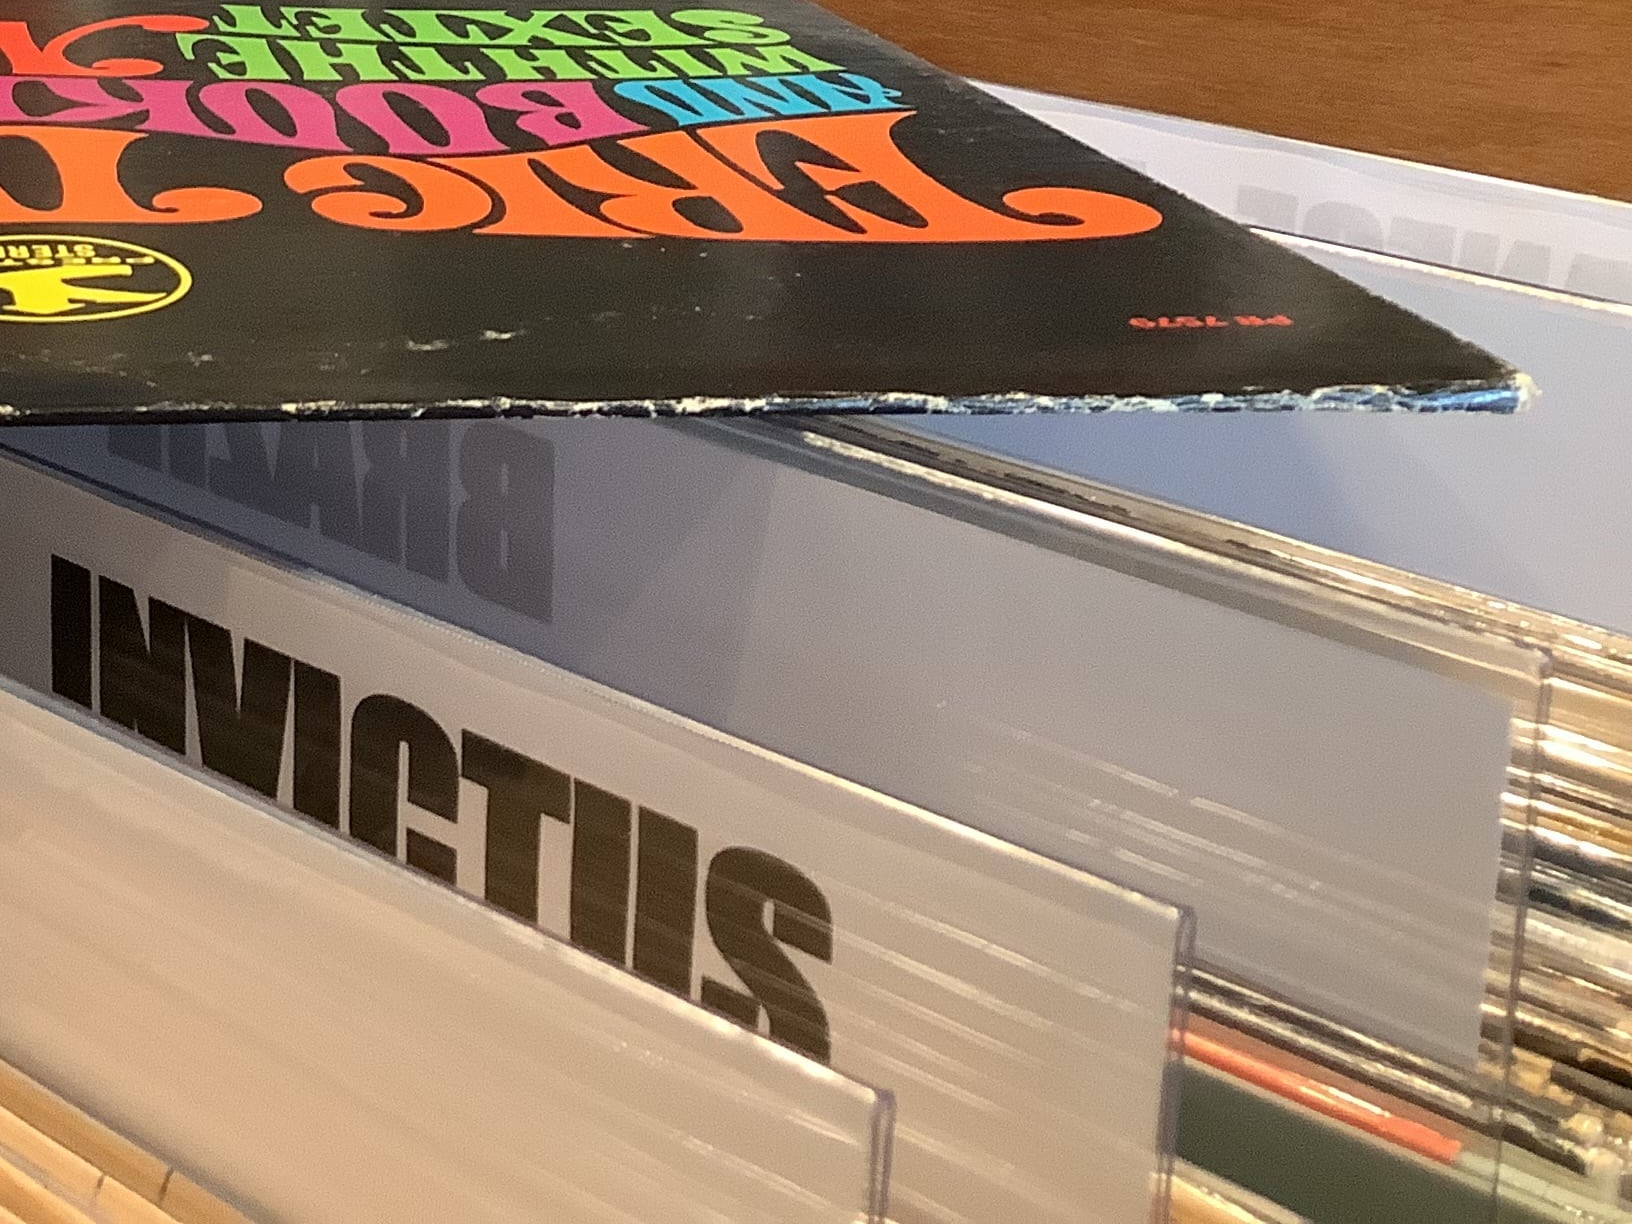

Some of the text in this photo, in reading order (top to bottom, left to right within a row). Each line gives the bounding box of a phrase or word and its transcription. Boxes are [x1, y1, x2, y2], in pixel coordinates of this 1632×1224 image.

[212, 4, 792, 46] SEXTET
[613, 73, 911, 126] AND
[283, 110, 1165, 244] ERIC
